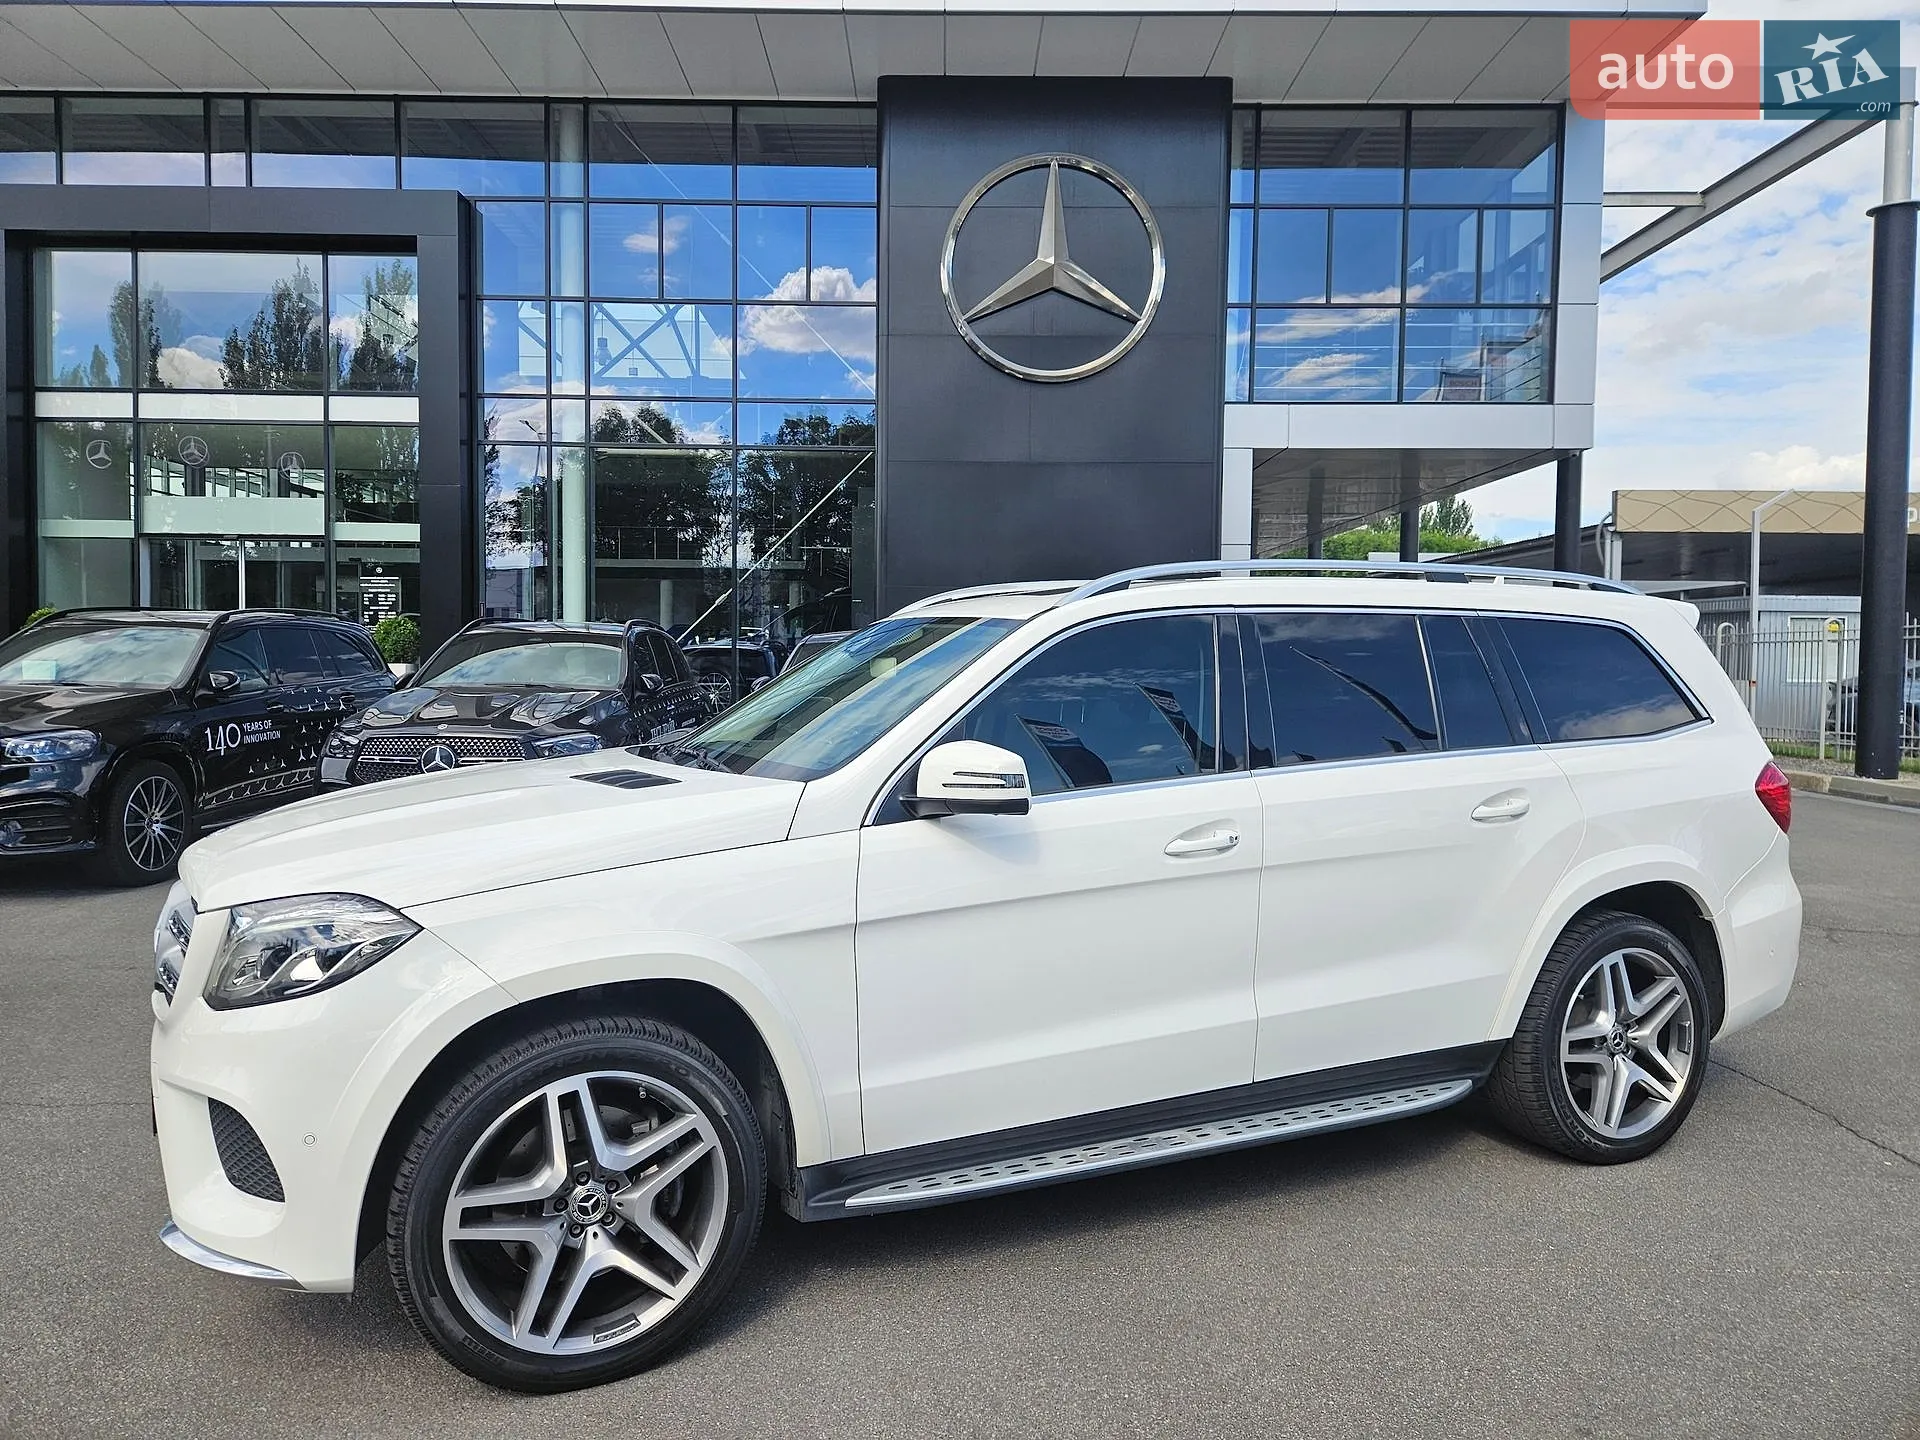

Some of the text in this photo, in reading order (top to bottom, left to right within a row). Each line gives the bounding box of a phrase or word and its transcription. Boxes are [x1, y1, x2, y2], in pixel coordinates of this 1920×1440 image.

[204, 720, 272, 756] 140 YEARS OF
[243, 730, 281, 744] INNOVATION
